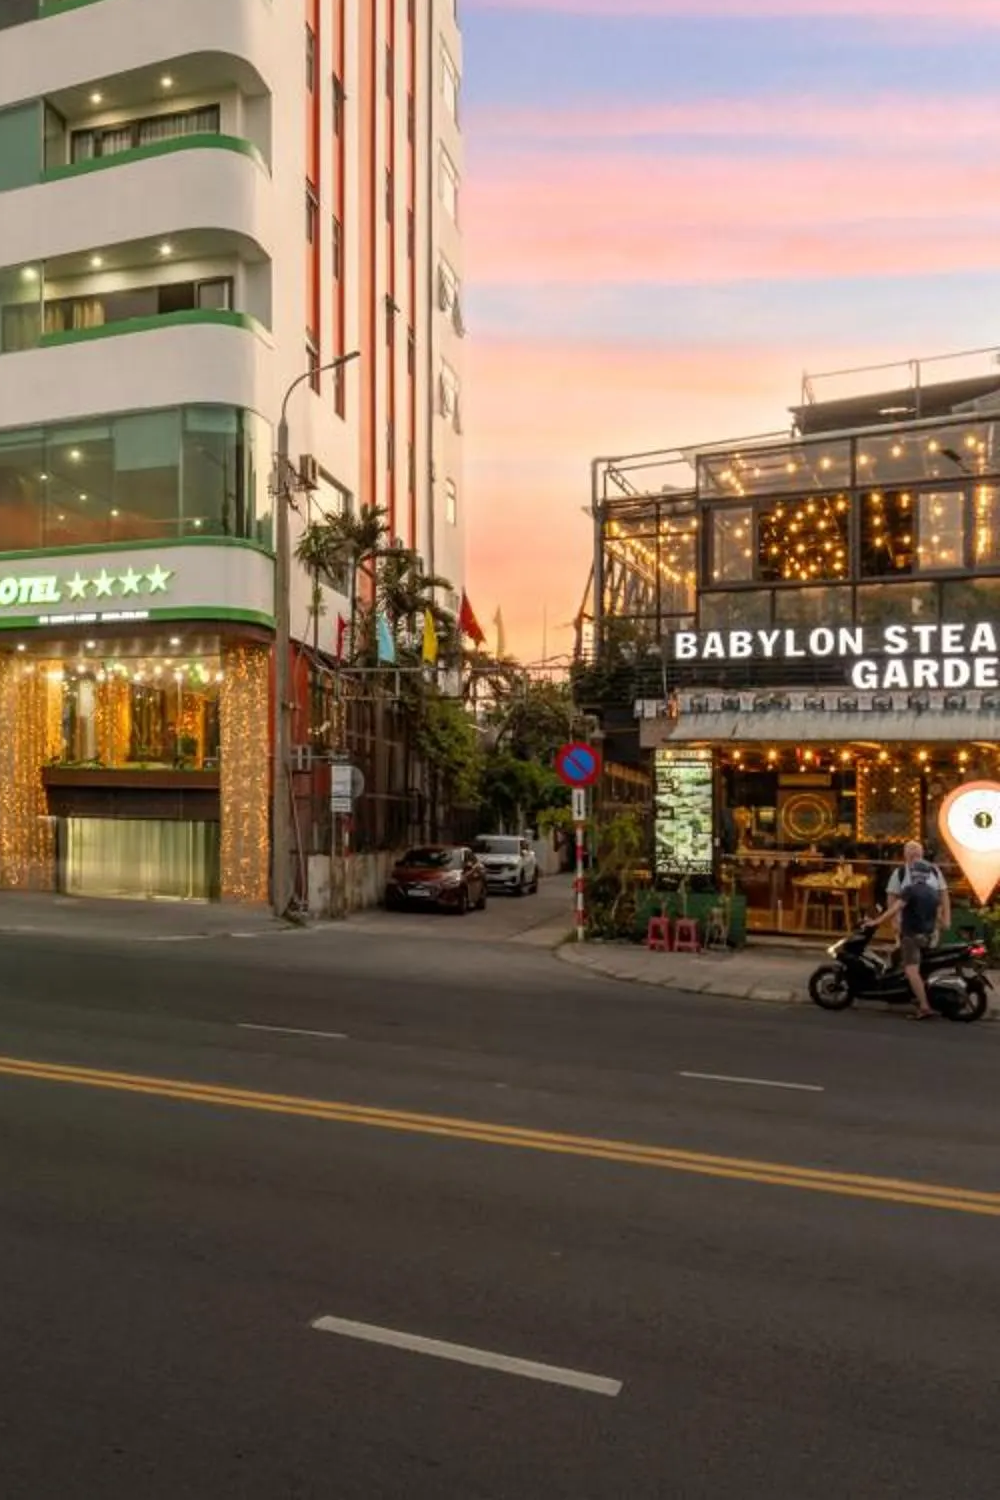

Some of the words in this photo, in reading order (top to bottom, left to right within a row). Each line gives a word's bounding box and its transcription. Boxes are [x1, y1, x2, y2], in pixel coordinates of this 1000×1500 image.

[674, 627, 863, 660] BABYLON
[884, 622, 997, 654] STEA
[851, 657, 1000, 689] GARDE
